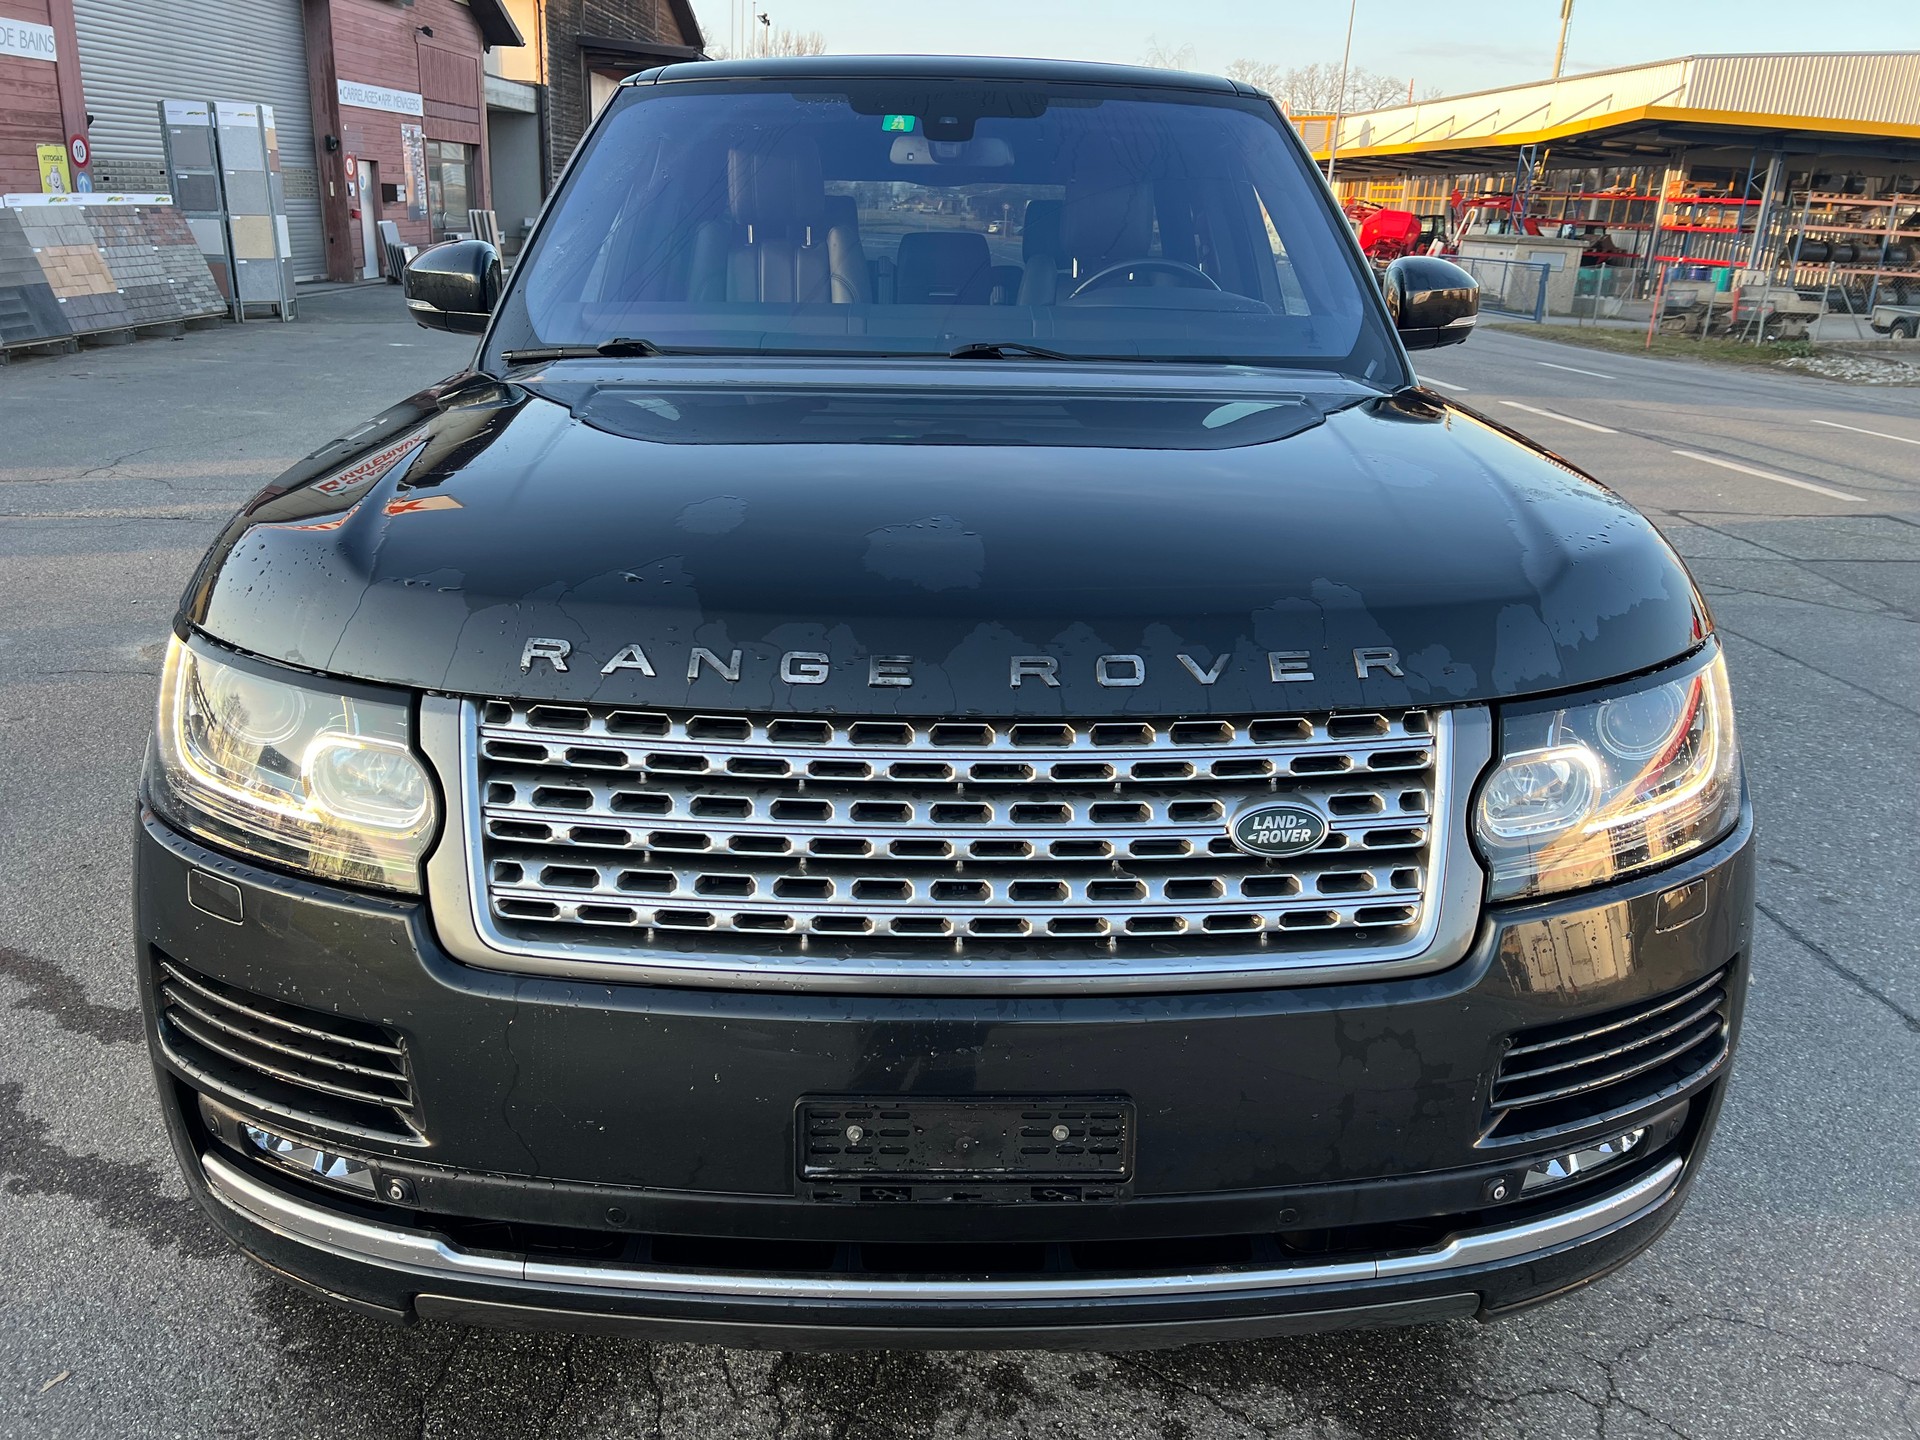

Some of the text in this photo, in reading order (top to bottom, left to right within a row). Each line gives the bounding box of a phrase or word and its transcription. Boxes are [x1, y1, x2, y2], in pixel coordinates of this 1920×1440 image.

[0, 26, 55, 53] DE BAINS
[342, 86, 378, 105] CARRELAGES
[75, 145, 85, 158] 10
[520, 637, 1405, 688] RANGE ROVER
[1252, 815, 1297, 830] LAND
[1257, 829, 1312, 844] ROVER
